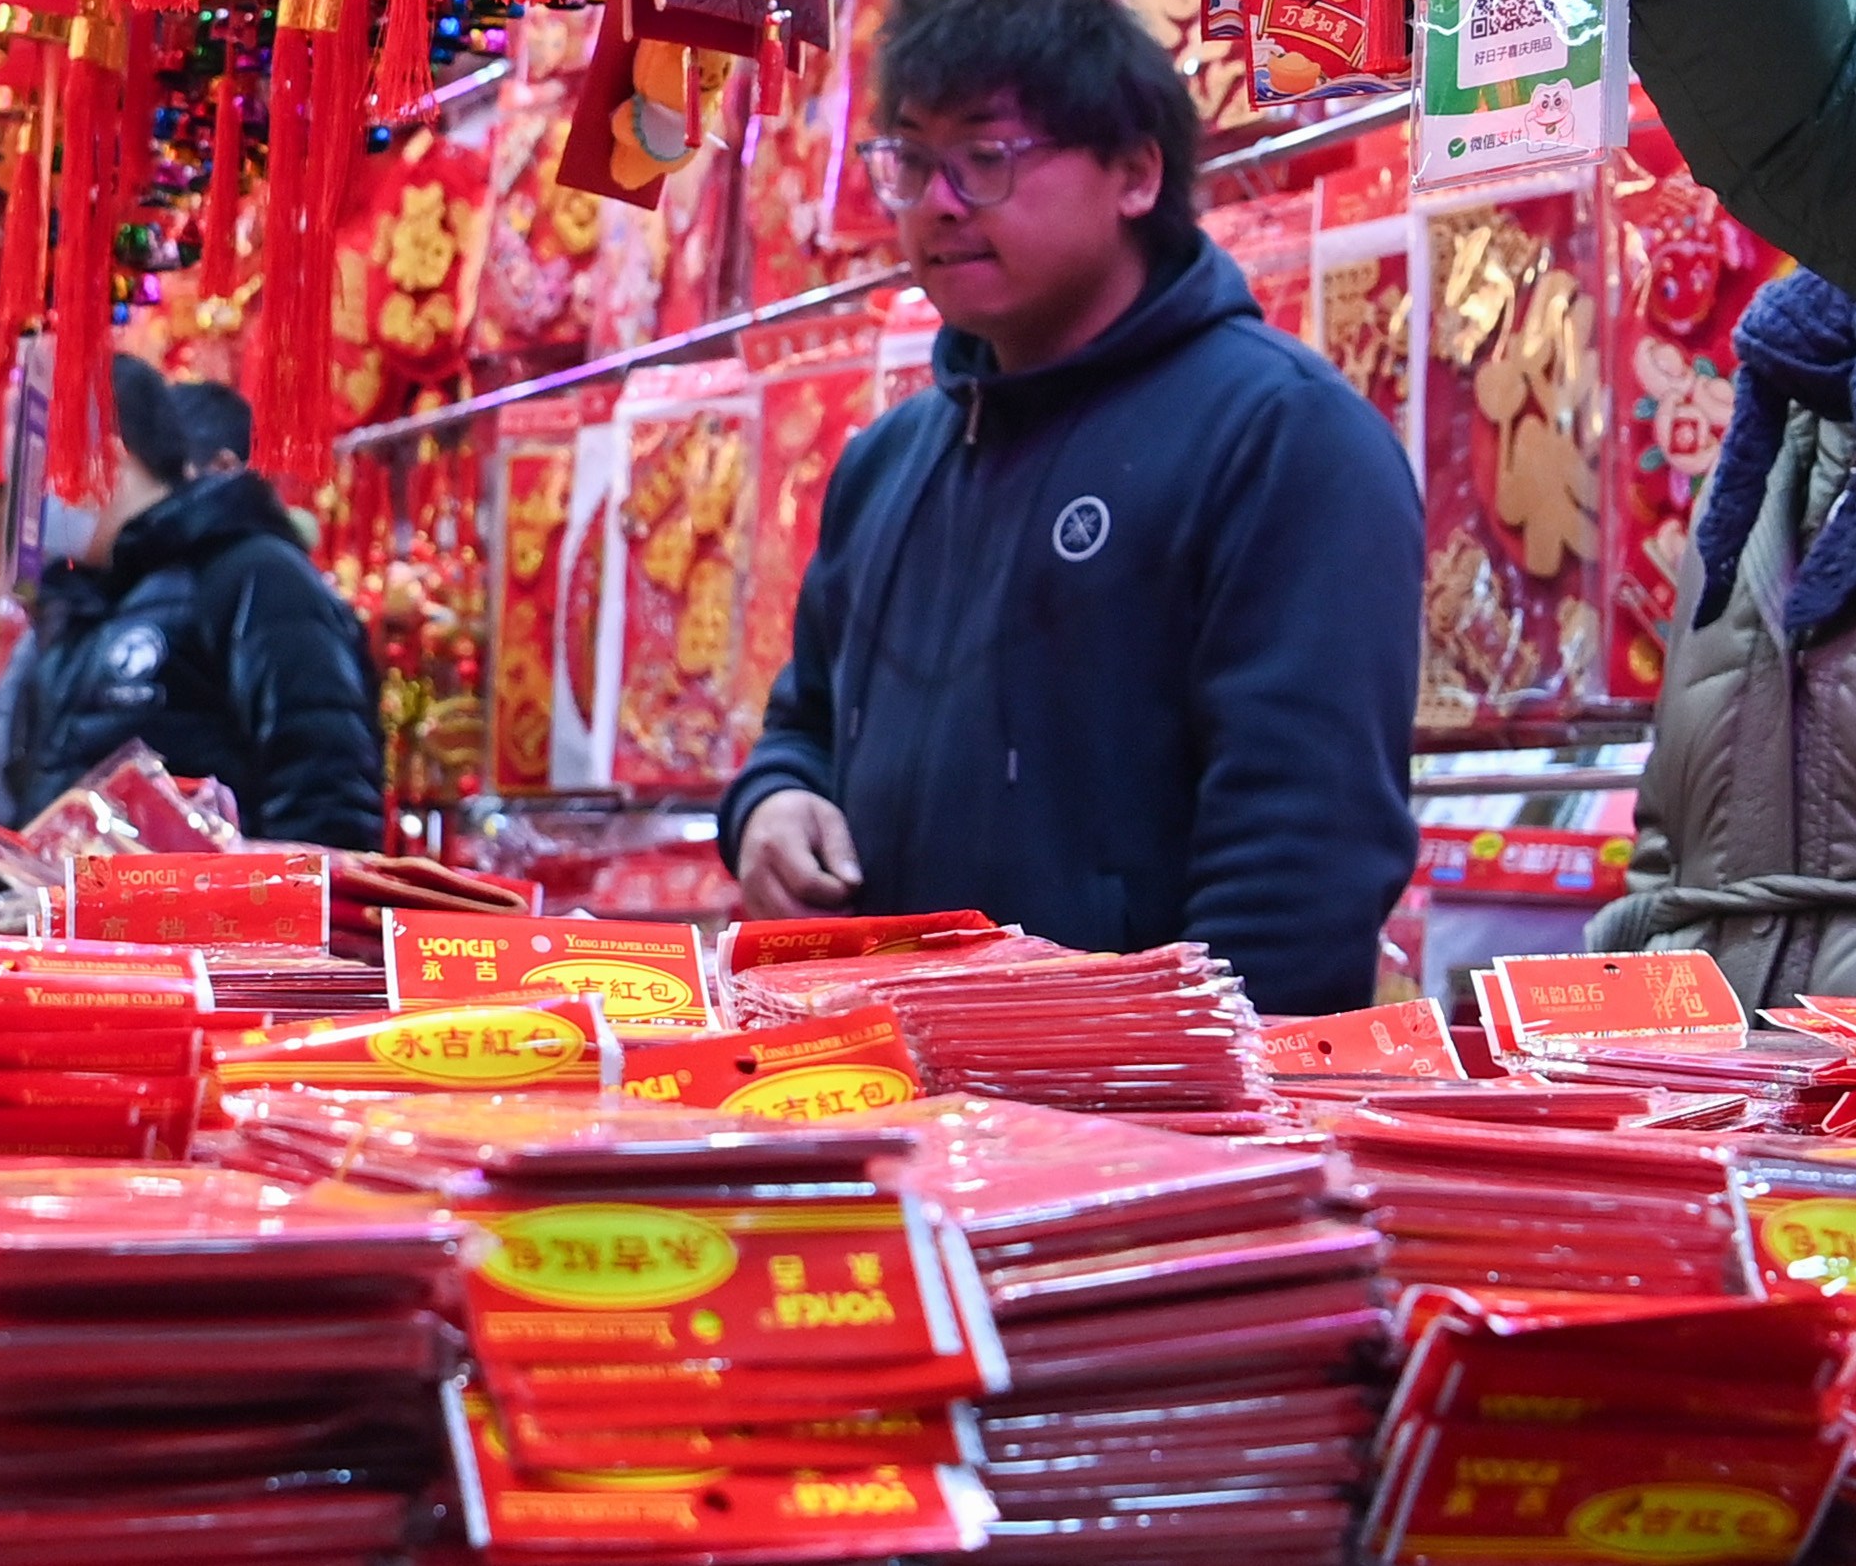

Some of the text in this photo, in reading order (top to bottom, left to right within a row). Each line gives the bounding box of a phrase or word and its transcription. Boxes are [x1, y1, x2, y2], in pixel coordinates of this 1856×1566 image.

[1278, 4, 1348, 44] 万事如意
[1474, 37, 1553, 66] 好日子喜庆用品
[1469, 127, 1523, 154] 微信支付
[564, 933, 598, 949] YONG
[610, 940, 643, 951] PAPER
[422, 960, 498, 982] 永吉
[26, 986, 70, 1003] YONG
[86, 992, 130, 1005] PAPER
[391, 1026, 570, 1061] 永吉紅包
[750, 1043, 789, 1062] YONG
[803, 1035, 843, 1055] PAPER
[1258, 1033, 1312, 1056] ONGJI
